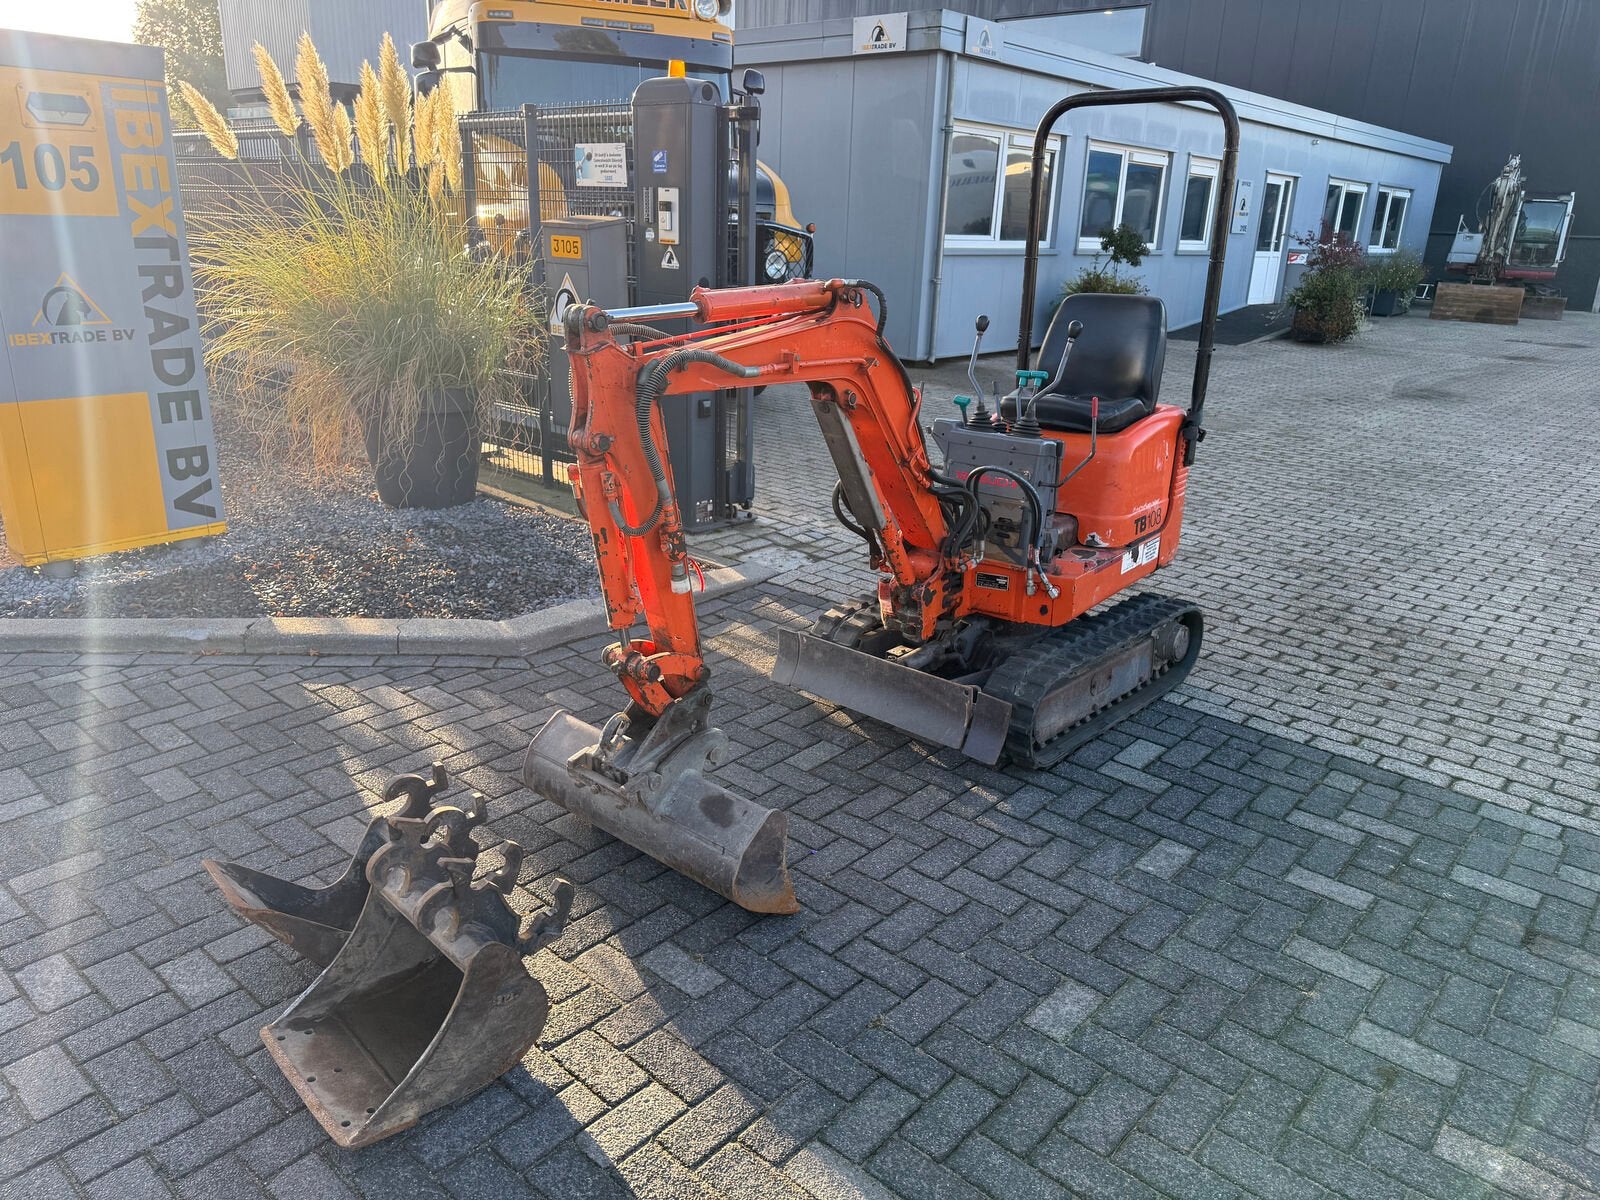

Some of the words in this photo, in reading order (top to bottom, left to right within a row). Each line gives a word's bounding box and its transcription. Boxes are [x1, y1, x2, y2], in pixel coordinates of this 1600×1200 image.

[0, 141, 99, 192] 105
[109, 86, 203, 425] IBEXTRADE
[166, 444, 217, 519] BV
[8, 331, 107, 347] IBEXTRADE
[112, 328, 135, 341] BV
